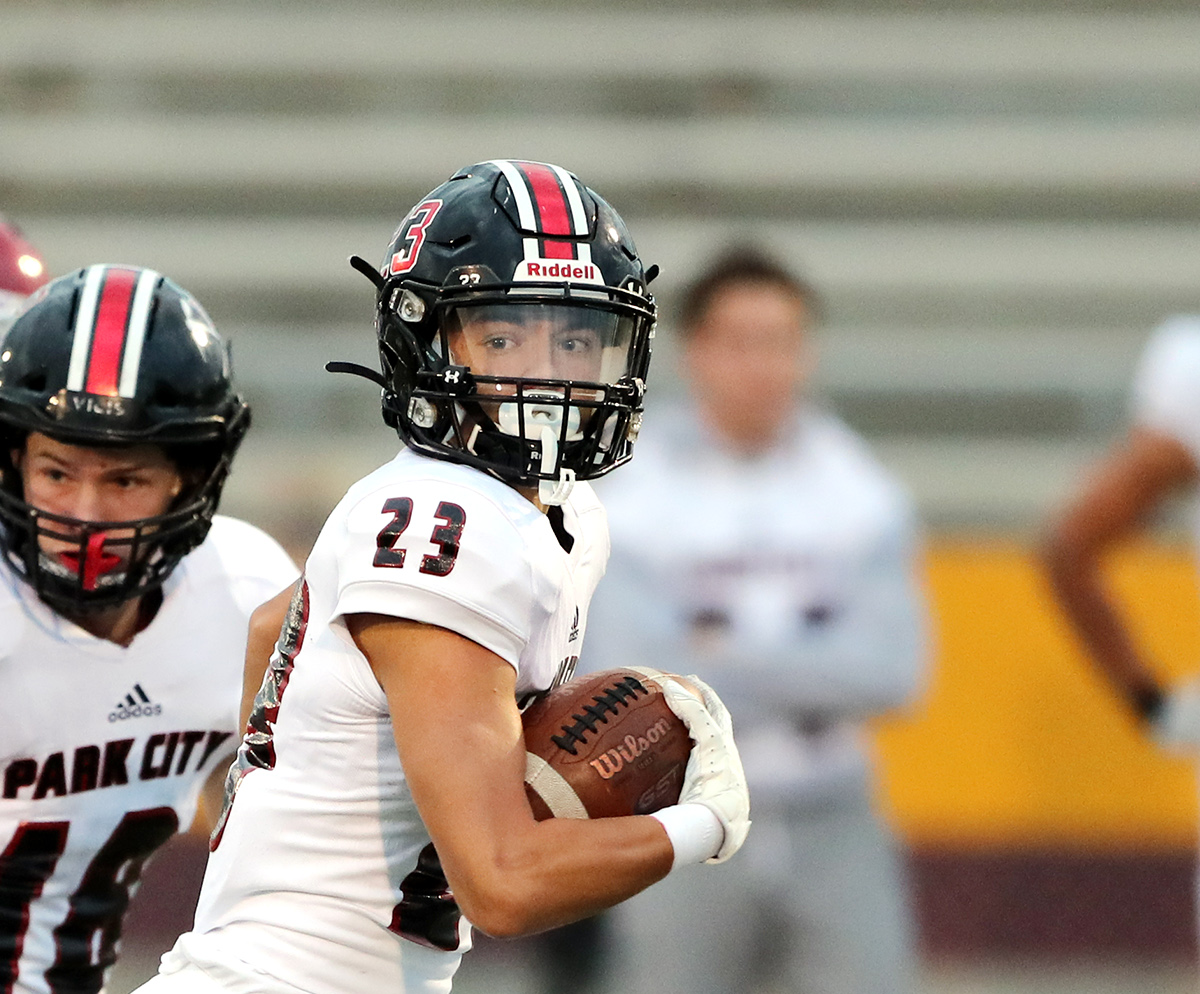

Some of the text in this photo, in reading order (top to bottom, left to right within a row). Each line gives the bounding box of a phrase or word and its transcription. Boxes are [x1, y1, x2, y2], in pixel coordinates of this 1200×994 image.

[380, 199, 443, 278] 3
[527, 262, 594, 279] Riddell
[372, 496, 467, 577] 23
[108, 704, 161, 723] adidas
[2, 731, 234, 800] PARK CITY
[590, 718, 672, 779] Wilson
